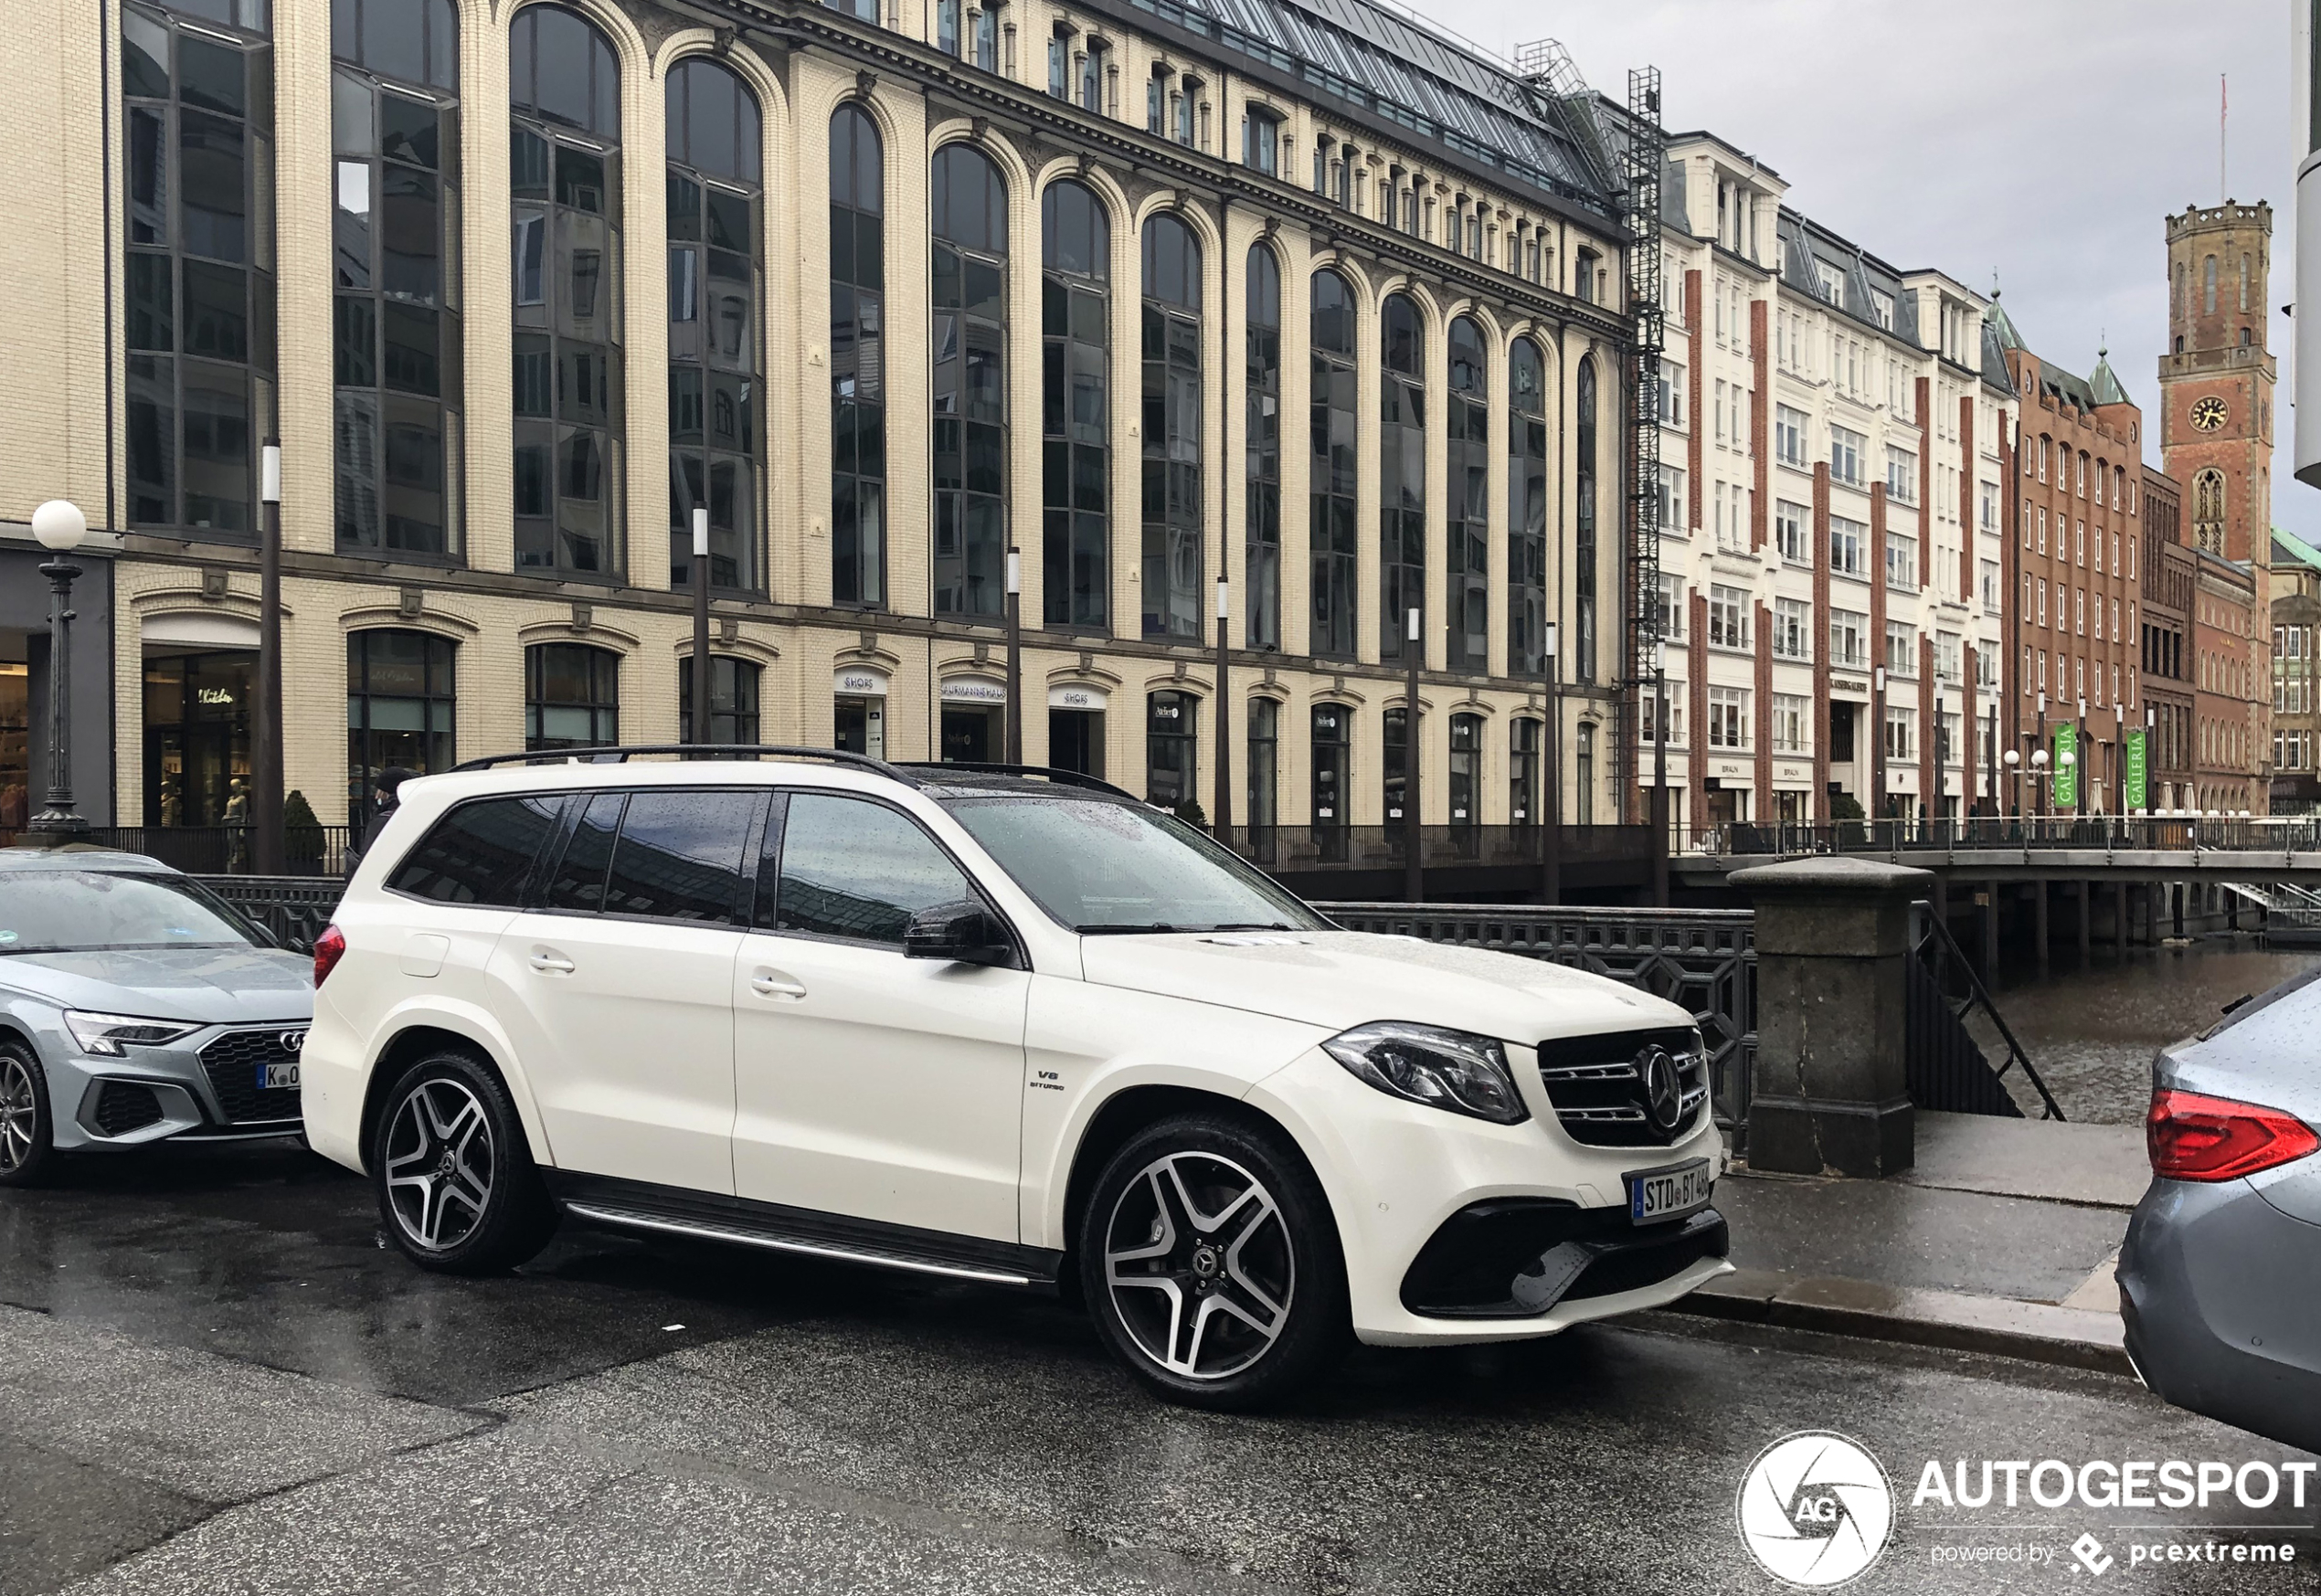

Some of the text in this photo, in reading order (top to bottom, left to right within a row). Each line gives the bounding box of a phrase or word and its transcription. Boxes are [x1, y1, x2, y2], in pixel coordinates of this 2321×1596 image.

[845, 677, 874, 689] SHOPS
[1064, 693, 1088, 703] SHOPS
[2060, 730, 2072, 802] GALLRIA
[2131, 736, 2143, 804] GALLERIA
[268, 1066, 278, 1085] K
[1038, 1071, 1058, 1080] V8
[1030, 1082, 1065, 1091] BITURBO
[1646, 1179, 1673, 1211] STD
[1683, 1173, 1695, 1204] BT
